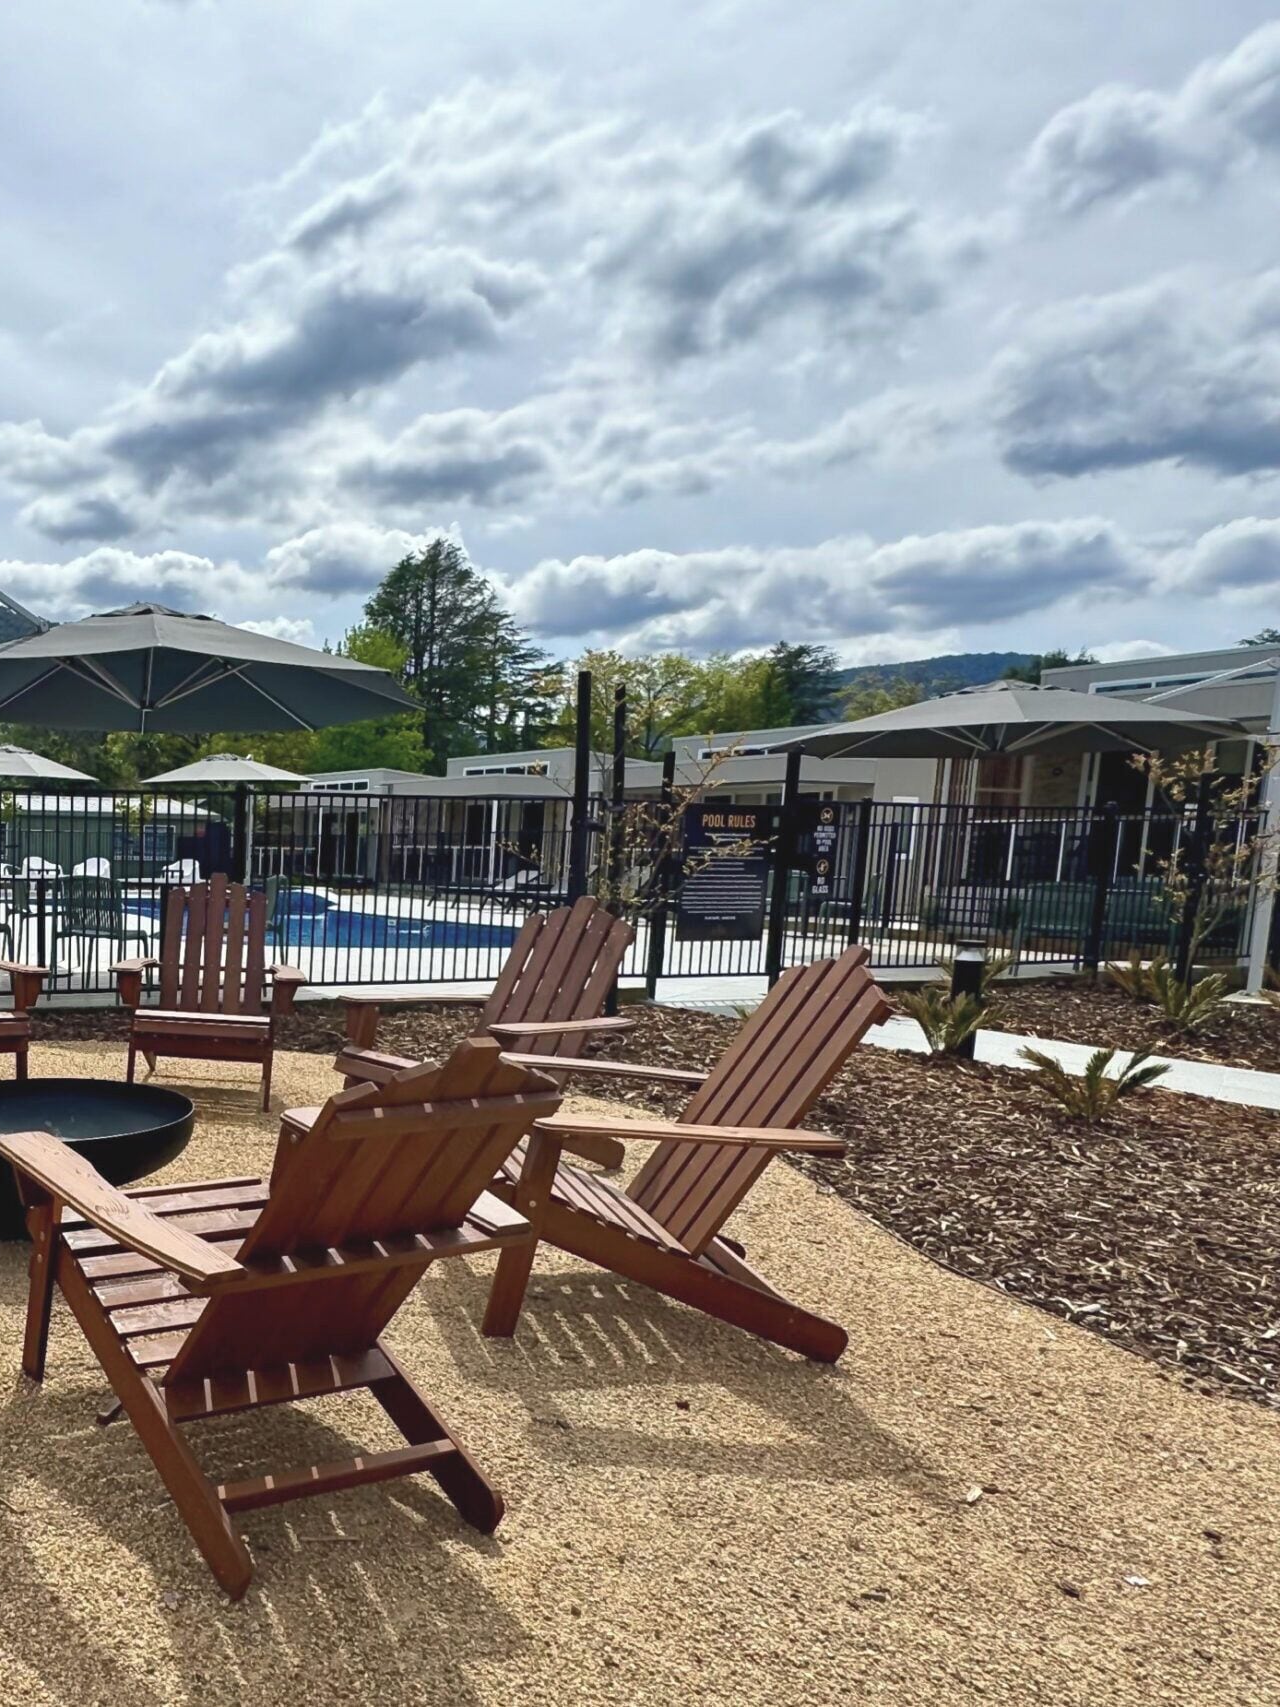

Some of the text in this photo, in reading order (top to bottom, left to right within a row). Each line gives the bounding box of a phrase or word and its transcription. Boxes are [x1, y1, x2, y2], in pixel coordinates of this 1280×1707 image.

[702, 814, 756, 828] POOL RULES
[817, 876, 825, 885] NO
[812, 885, 829, 894] GLASS
